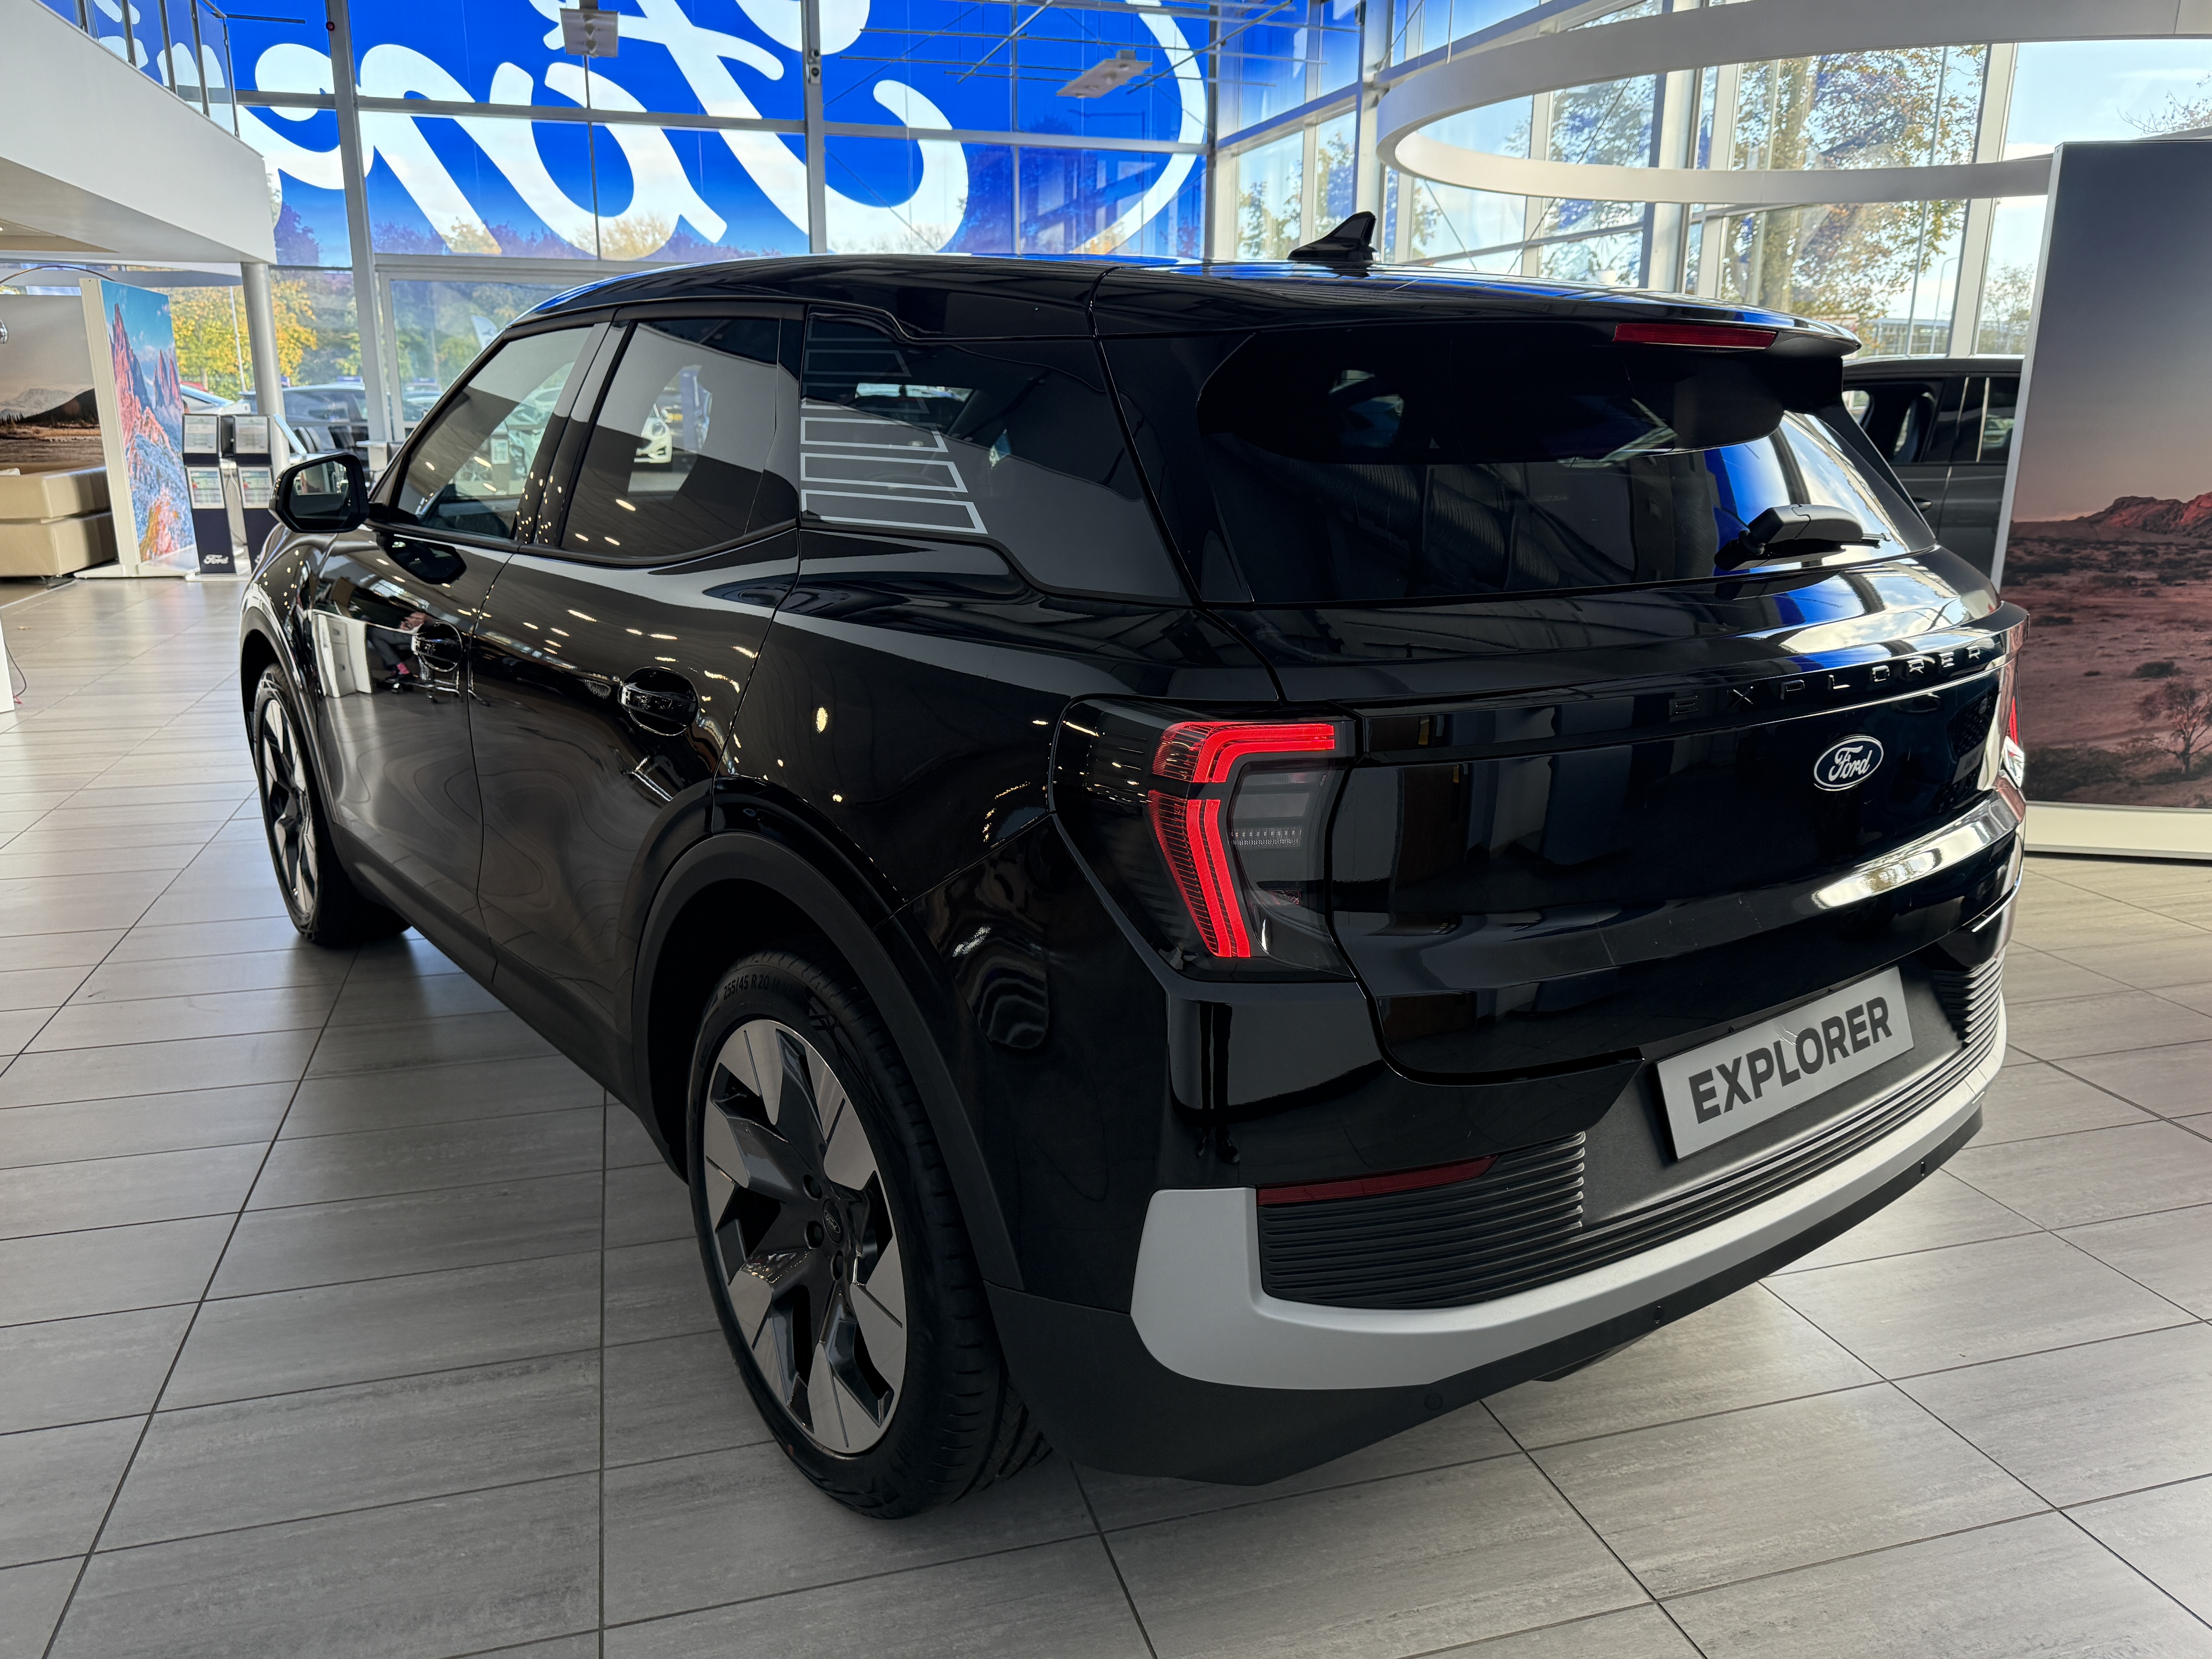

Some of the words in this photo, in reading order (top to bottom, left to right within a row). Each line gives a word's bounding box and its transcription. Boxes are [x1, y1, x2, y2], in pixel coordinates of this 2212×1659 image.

[203, 554, 229, 564] Ford
[1669, 645, 1980, 721] EXPLORER
[1828, 745, 1872, 781] Ford
[723, 974, 748, 1000] 255/45
[751, 974, 756, 989] R
[758, 974, 769, 991] 20
[1688, 996, 1893, 1124] EXPLORER
